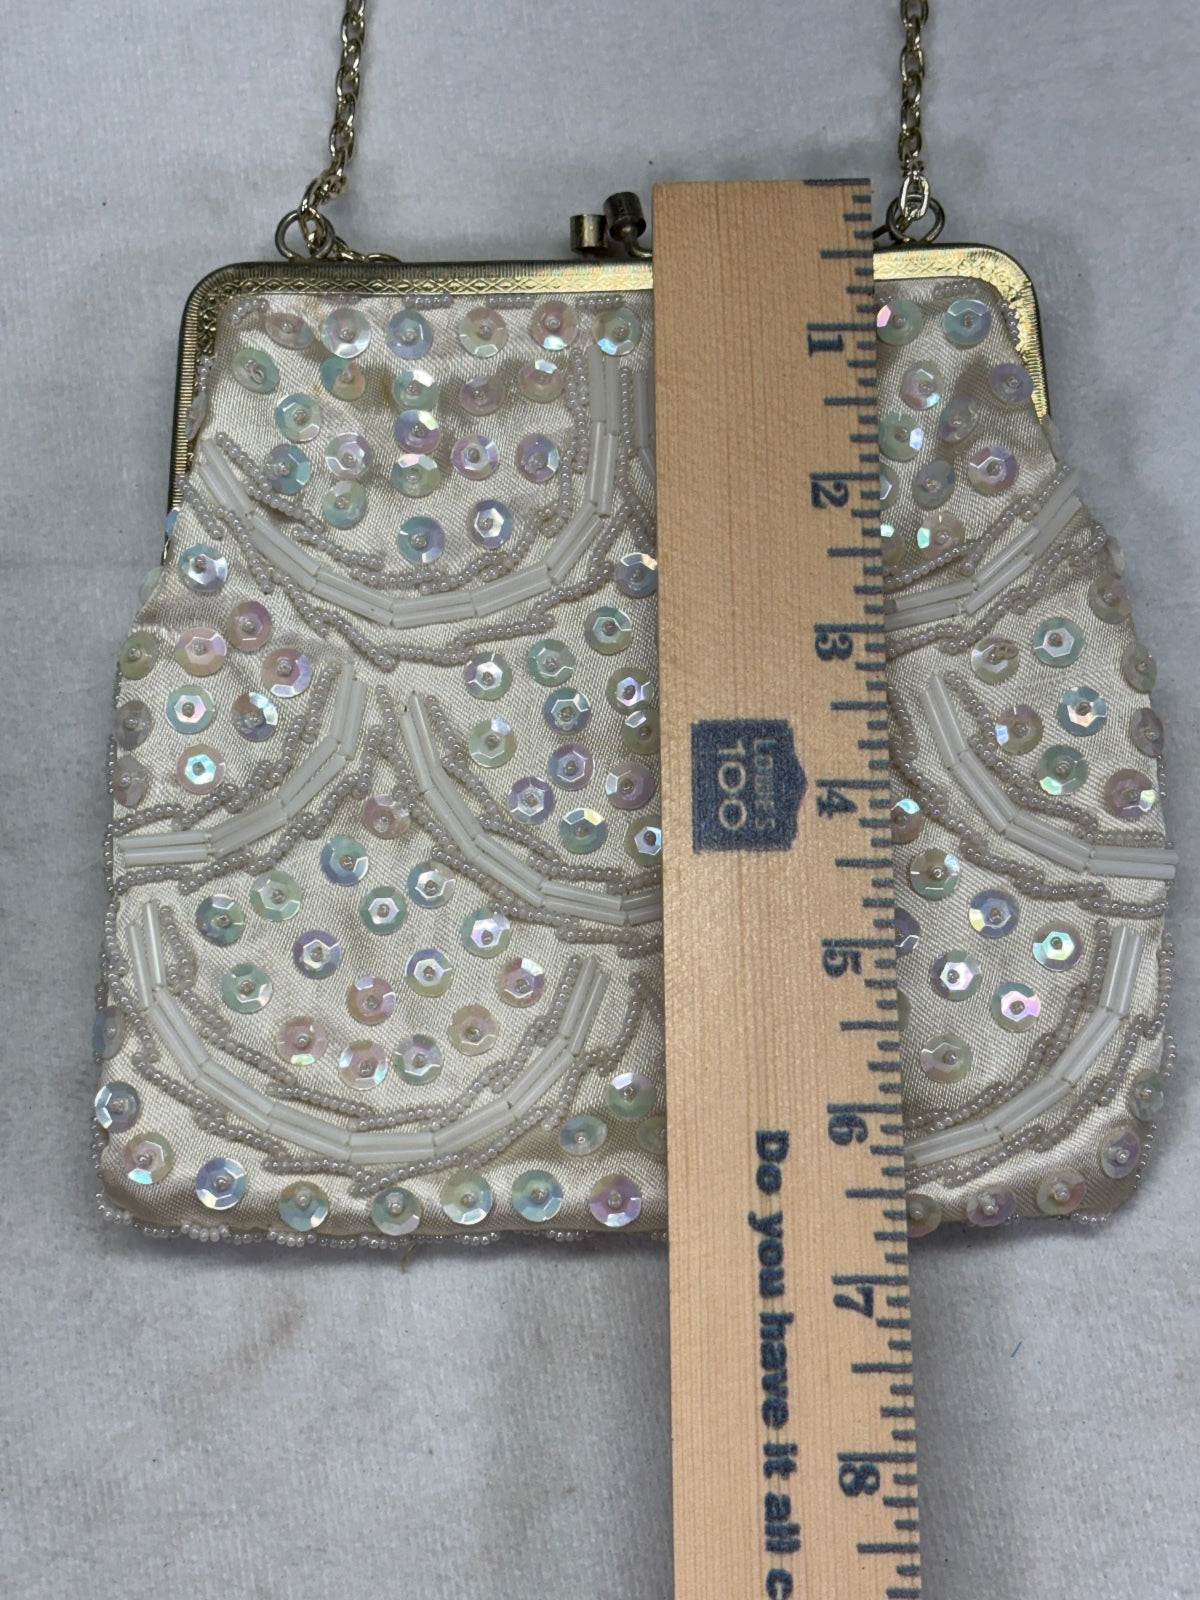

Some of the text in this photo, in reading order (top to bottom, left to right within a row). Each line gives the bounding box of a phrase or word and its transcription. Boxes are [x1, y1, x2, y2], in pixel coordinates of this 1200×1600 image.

[807, 334, 843, 357] 1
[811, 480, 849, 508] 2
[815, 632, 853, 661] 3
[718, 739, 747, 830] 100
[816, 787, 857, 818] 4
[823, 949, 862, 978] 5
[828, 1113, 868, 1145] 6
[755, 1130, 789, 1195] Do
[748, 1211, 785, 1298] you
[833, 1285, 873, 1318] 7
[759, 1312, 794, 1429] have
[763, 1442, 798, 1479] it
[839, 1462, 880, 1497] 8
[764, 1492, 801, 1553] all
